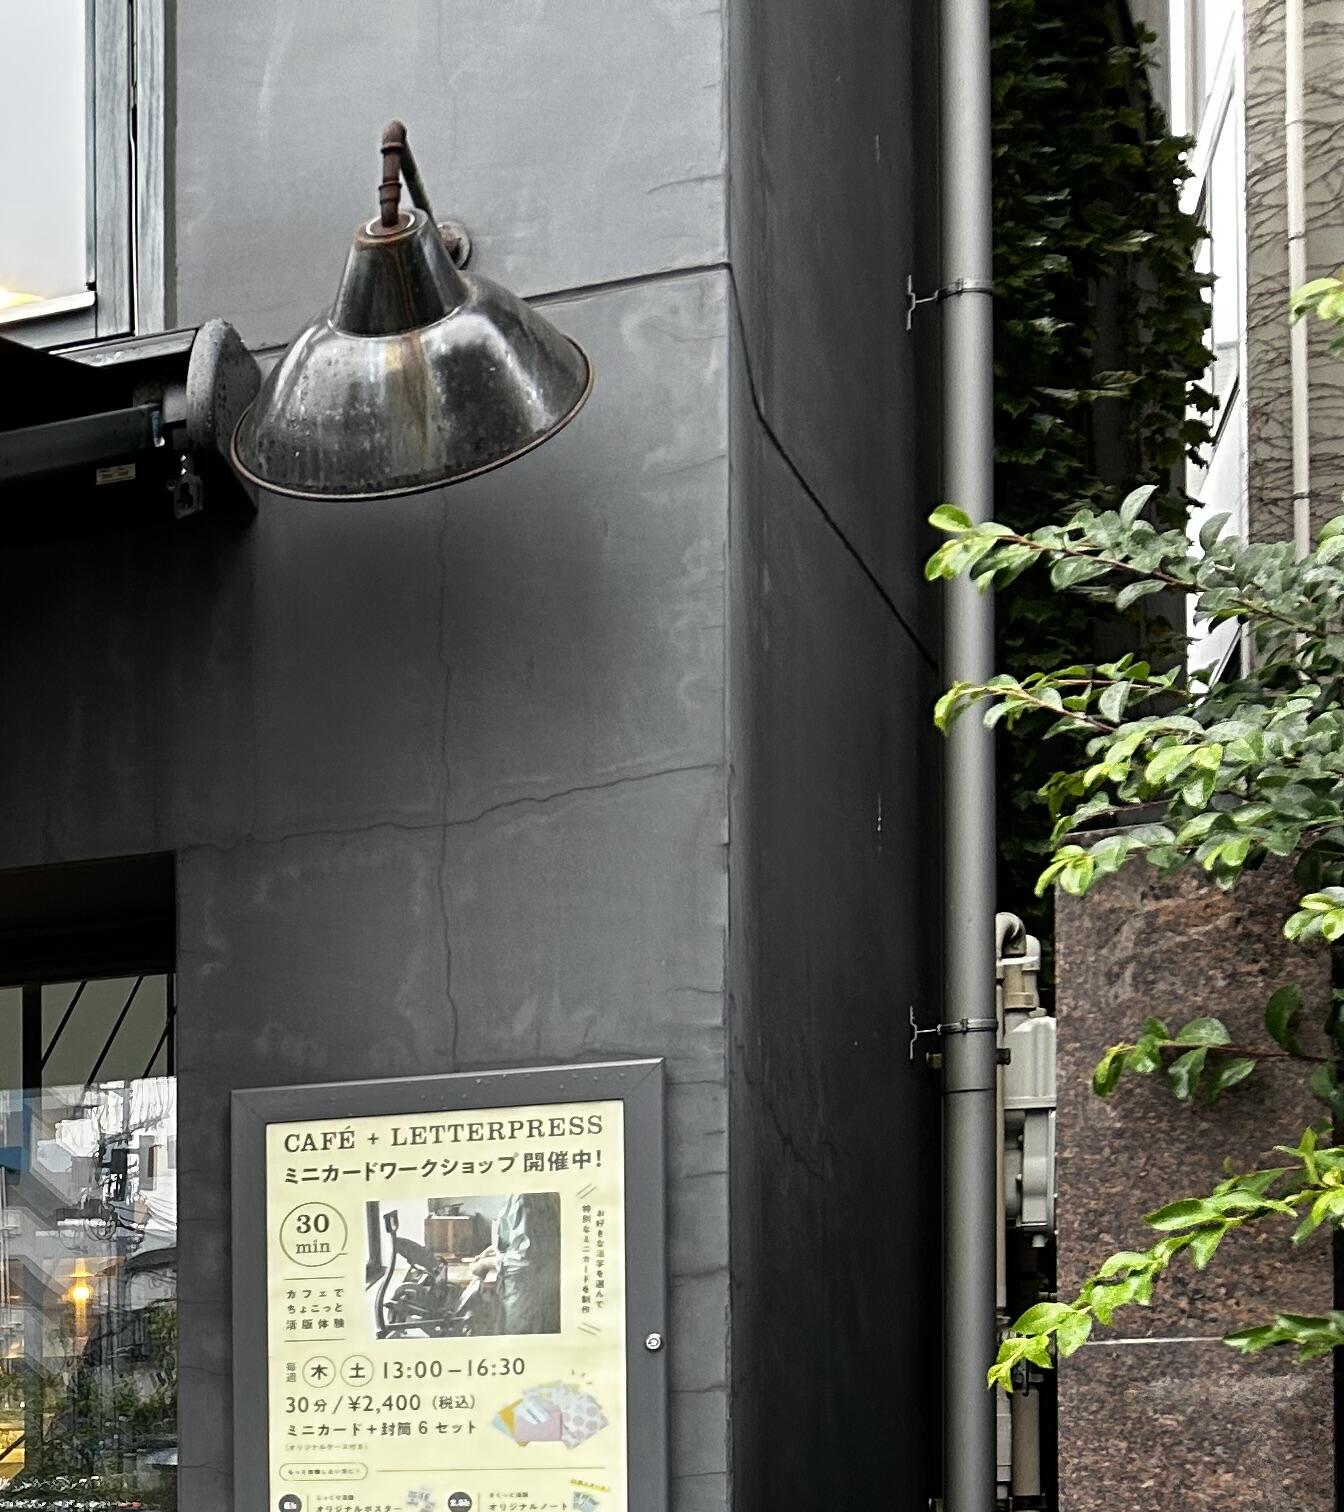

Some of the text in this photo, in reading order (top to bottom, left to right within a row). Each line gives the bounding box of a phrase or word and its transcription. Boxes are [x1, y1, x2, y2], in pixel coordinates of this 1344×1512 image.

[284, 1125, 356, 1153] CAFÉ
[391, 1114, 604, 1147] LETTERPRESS
[296, 1213, 330, 1234] 30
[296, 1239, 331, 1254] min
[310, 1363, 328, 1380] 木
[348, 1362, 366, 1379] 土
[348, 1394, 421, 1414] ¥2,400
